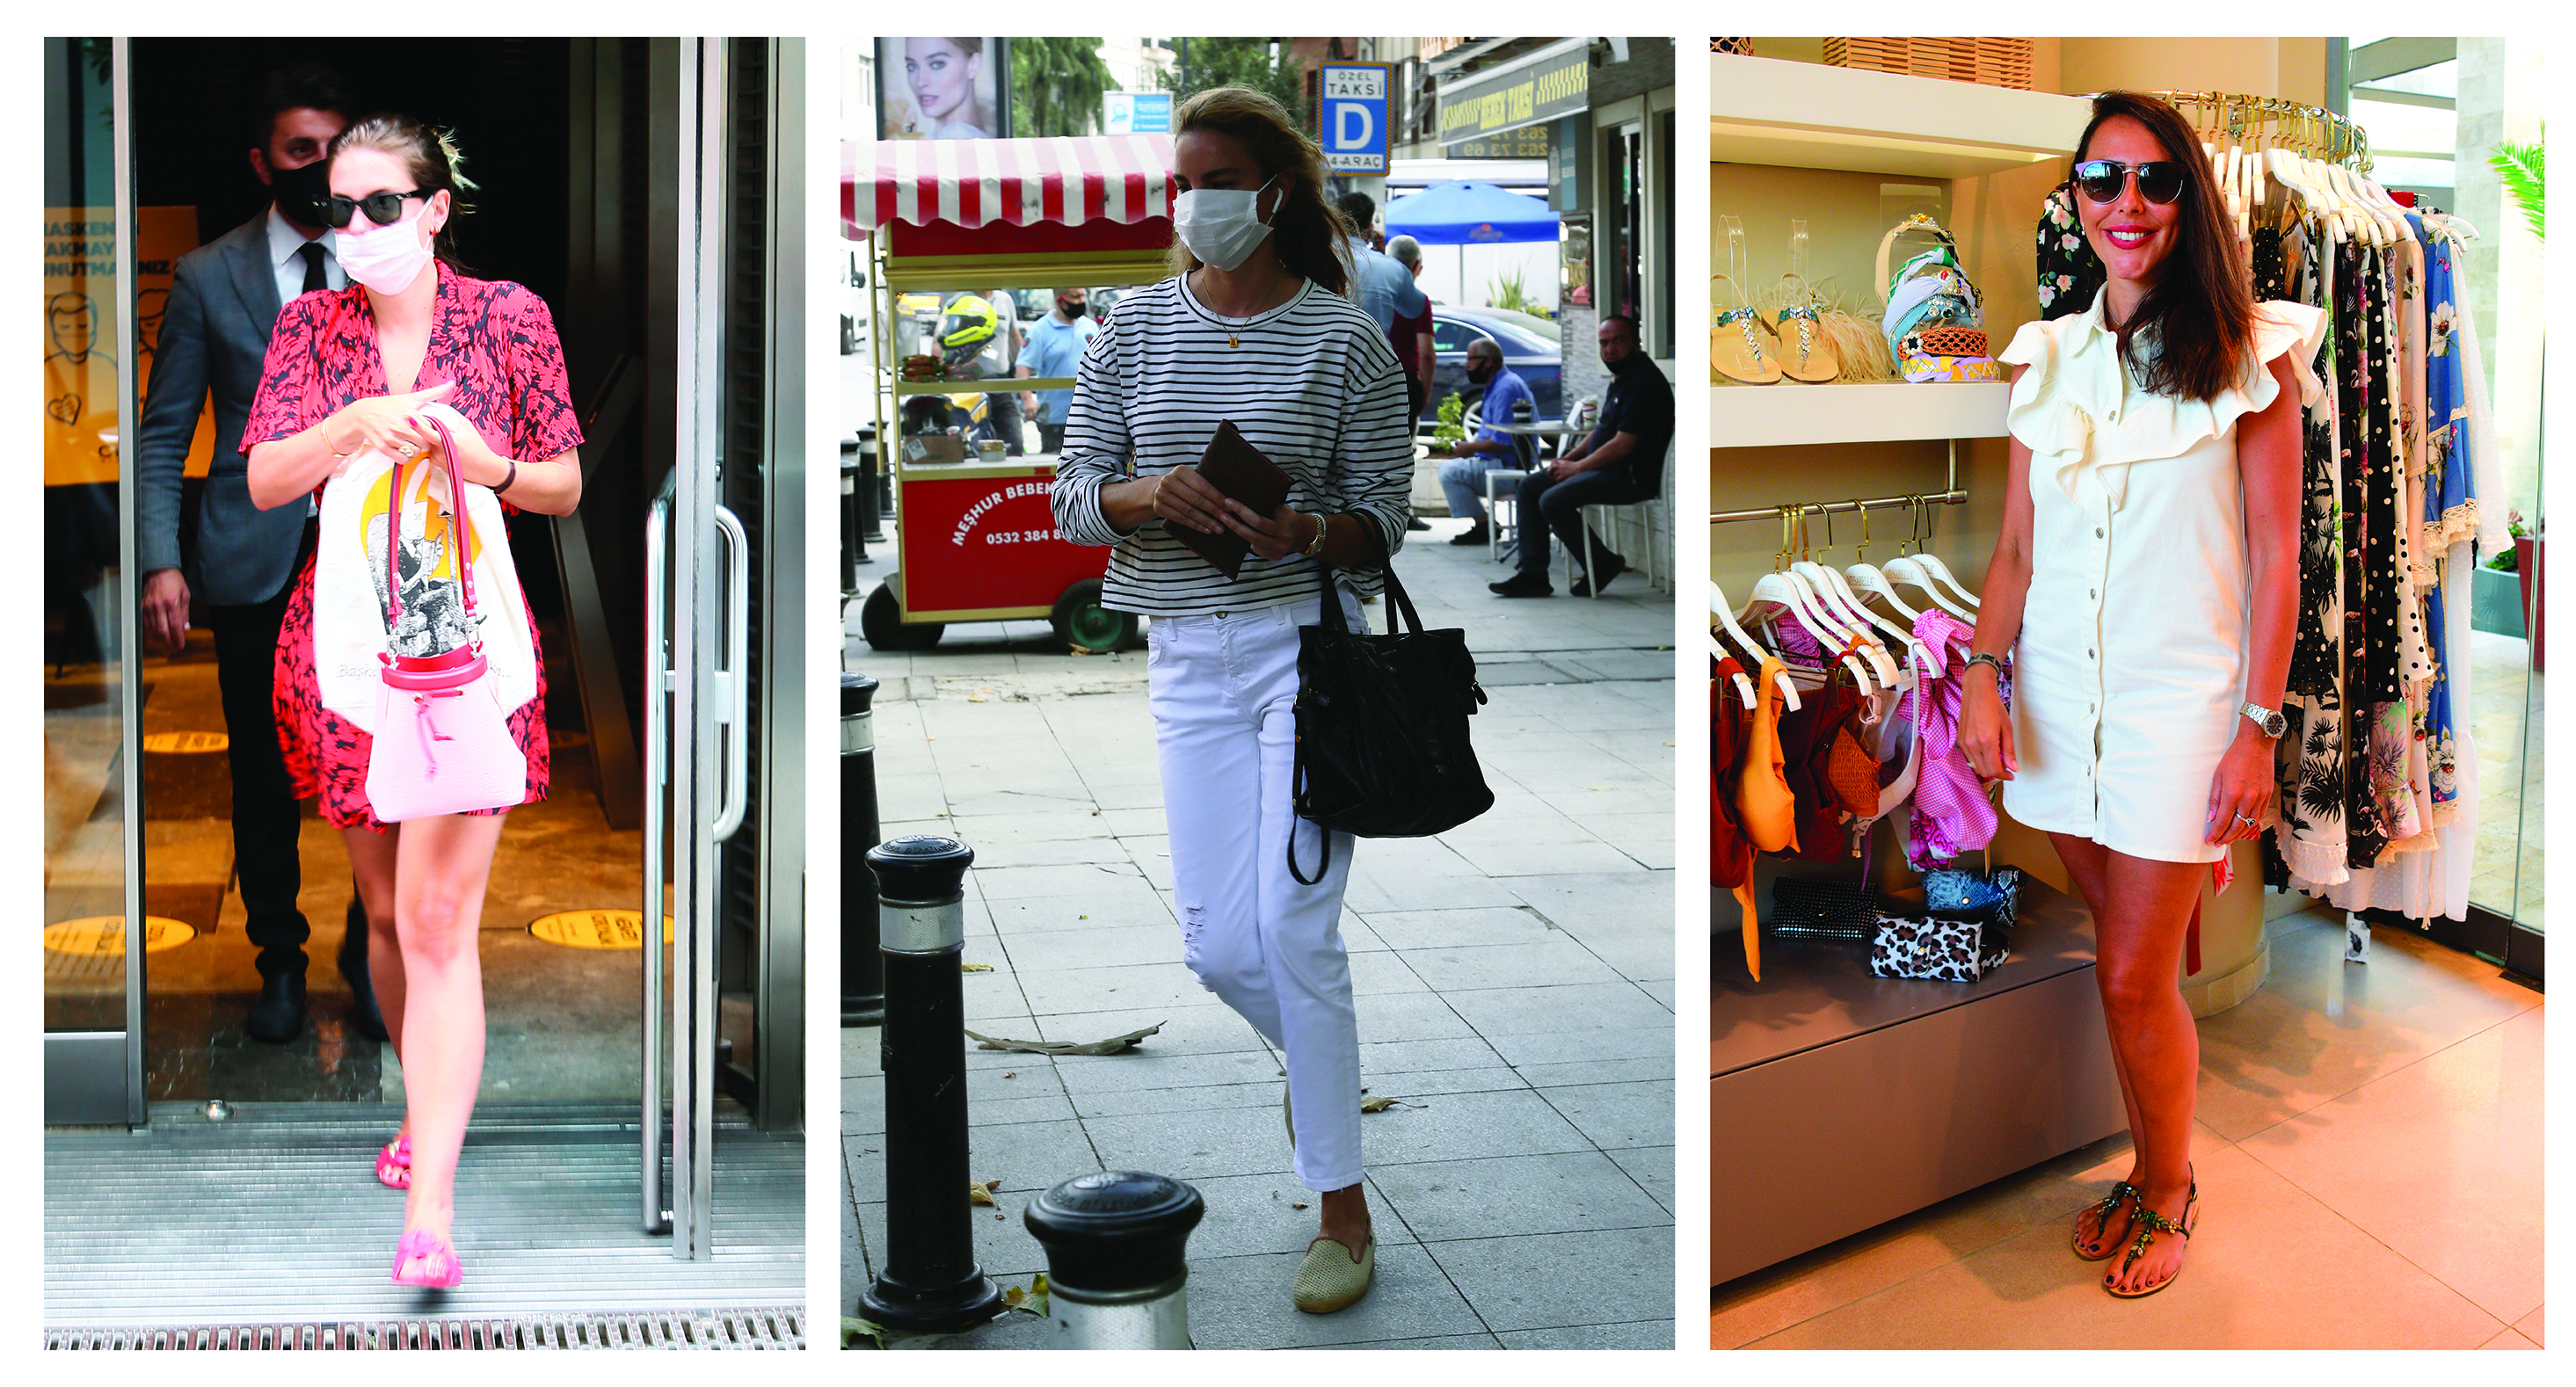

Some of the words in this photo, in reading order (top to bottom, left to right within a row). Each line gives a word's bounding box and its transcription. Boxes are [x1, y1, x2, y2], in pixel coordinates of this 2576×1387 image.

[1338, 70, 1372, 81] ÖZEL
[1328, 82, 1382, 96] TAKSİ
[1335, 102, 1373, 149] D
[952, 492, 1003, 546] MEŞHUR
[986, 532, 1020, 545] 0532
[1023, 529, 1049, 541] 384
